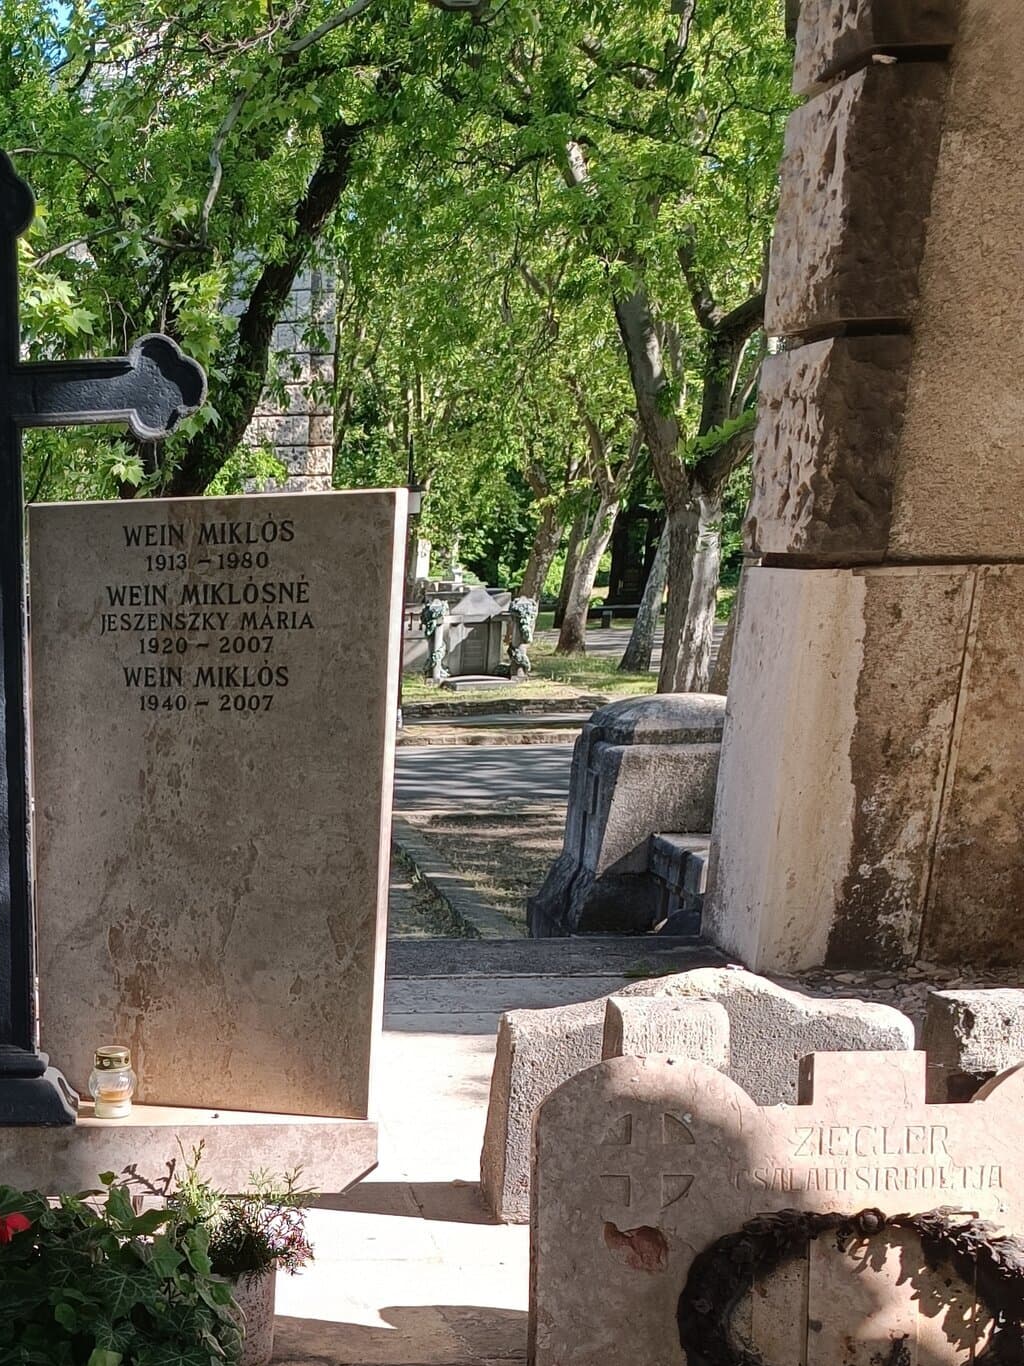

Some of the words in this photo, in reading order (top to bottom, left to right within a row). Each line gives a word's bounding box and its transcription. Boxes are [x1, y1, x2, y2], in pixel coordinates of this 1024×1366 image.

[123, 523, 185, 547] WEIN
[198, 512, 295, 545] MIKLÓS
[145, 554, 188, 572] 1913
[217, 551, 269, 569] 1980
[106, 584, 168, 607] WEIN
[180, 574, 310, 605] MIKLÓSNÉ
[100, 612, 230, 636] JESZENSZKY
[240, 605, 315, 630] MÁRIA
[139, 637, 188, 655] 1920
[219, 636, 274, 653] 2007
[123, 666, 182, 688] WEIN
[194, 659, 290, 688] MIKLÓS
[139, 696, 188, 712] 1940
[219, 694, 274, 712] 2007
[793, 1124, 950, 1157] ZIEGLER
